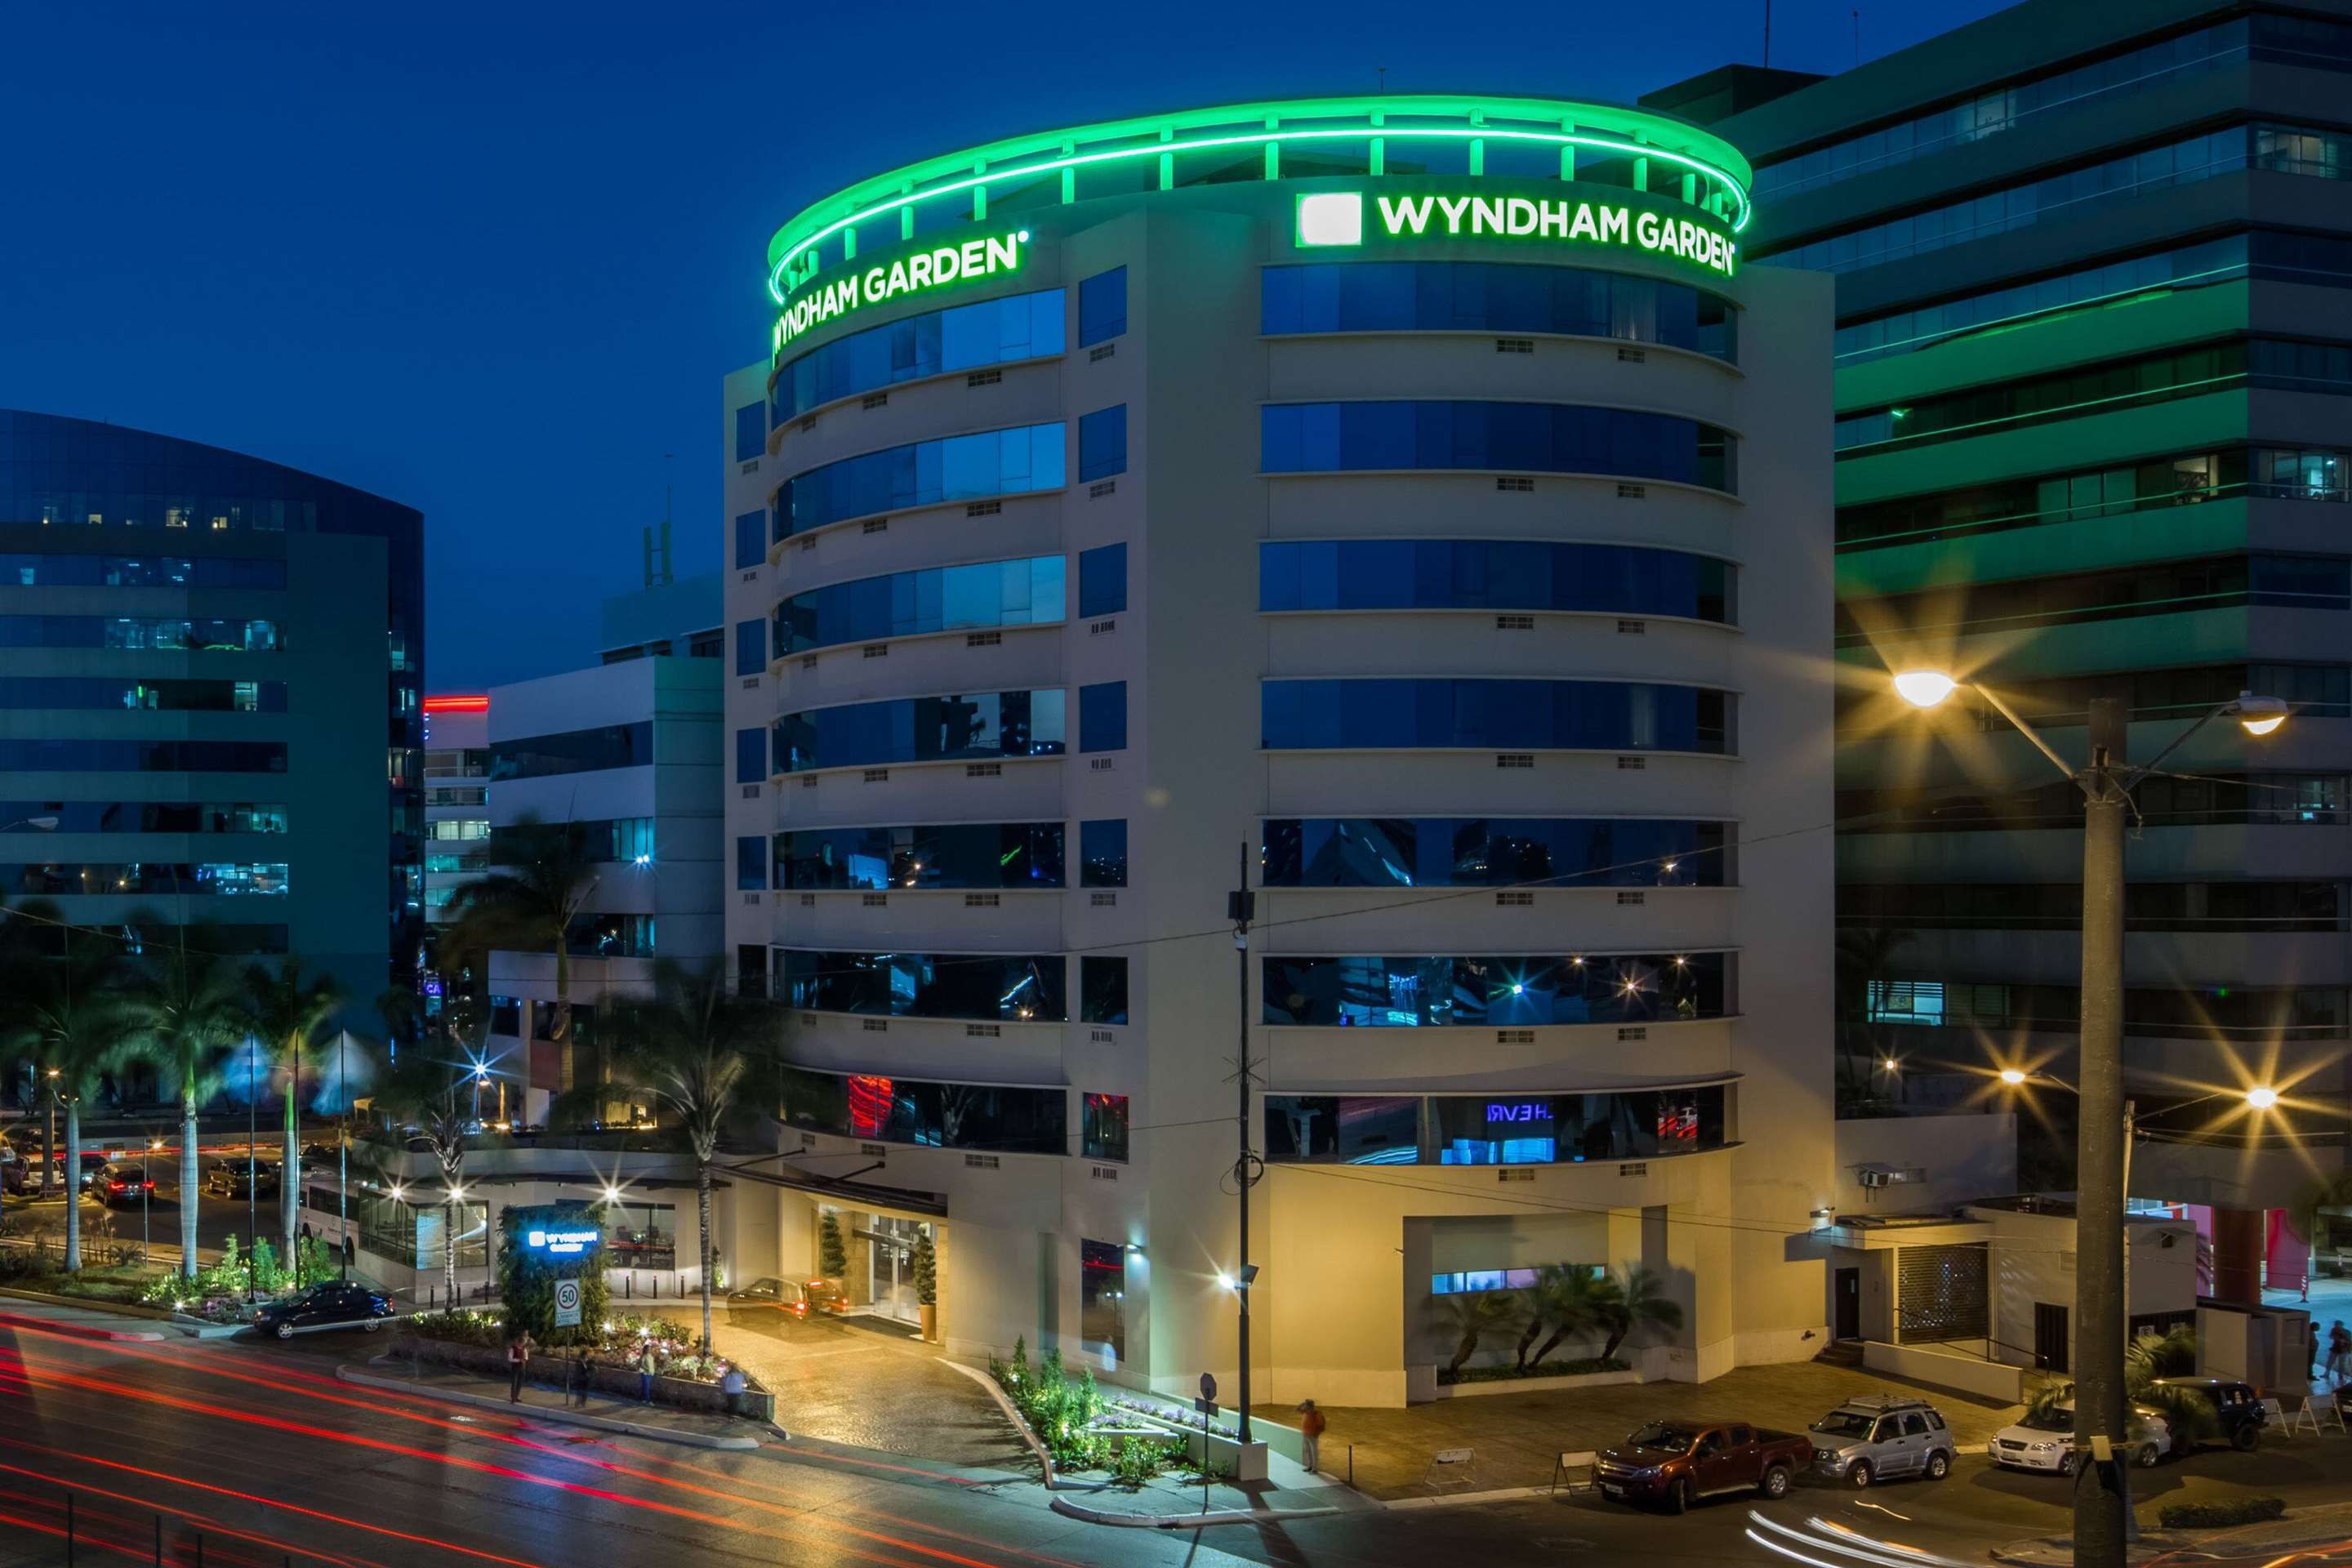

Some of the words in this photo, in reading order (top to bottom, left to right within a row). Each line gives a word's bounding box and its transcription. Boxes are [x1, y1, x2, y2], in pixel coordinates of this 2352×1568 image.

[1378, 196, 1629, 244] WYNDHAM
[1637, 212, 1733, 276] GARDEN
[774, 274, 858, 354] WYNDHAM
[864, 234, 1017, 303] GARDEN
[562, 1290, 575, 1303] 50
